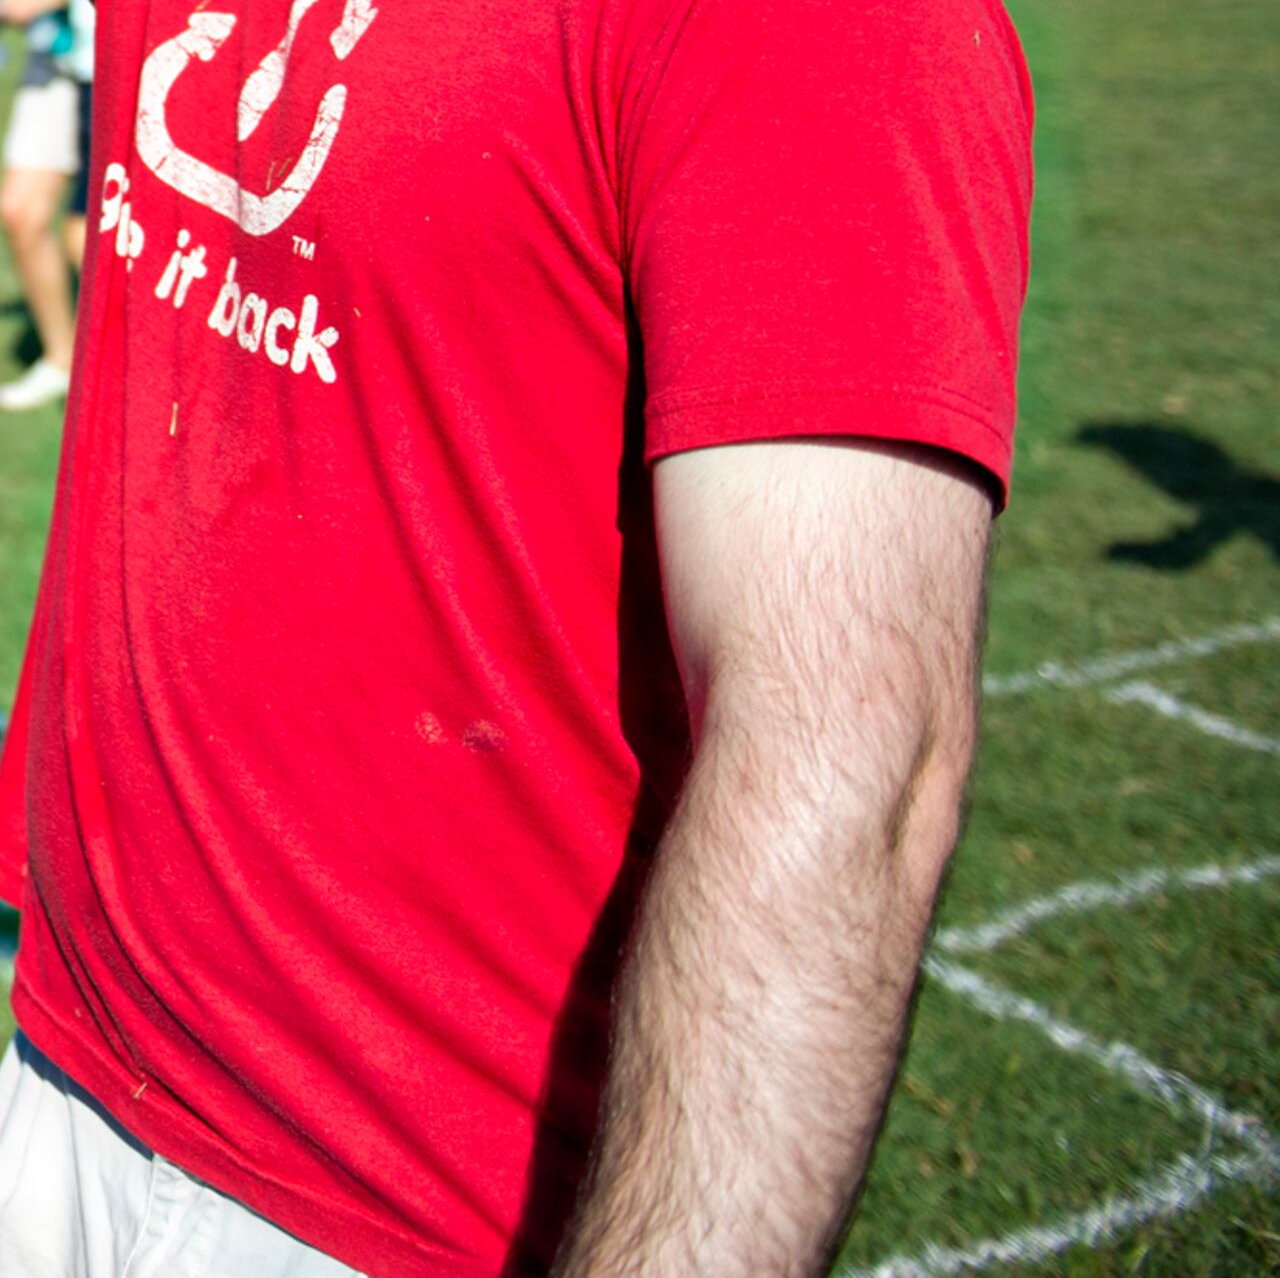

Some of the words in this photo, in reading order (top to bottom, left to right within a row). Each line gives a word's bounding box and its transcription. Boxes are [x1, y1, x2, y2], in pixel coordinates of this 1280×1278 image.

[291, 235, 316, 261] TM
[154, 229, 208, 309] it
[208, 257, 339, 384] back
